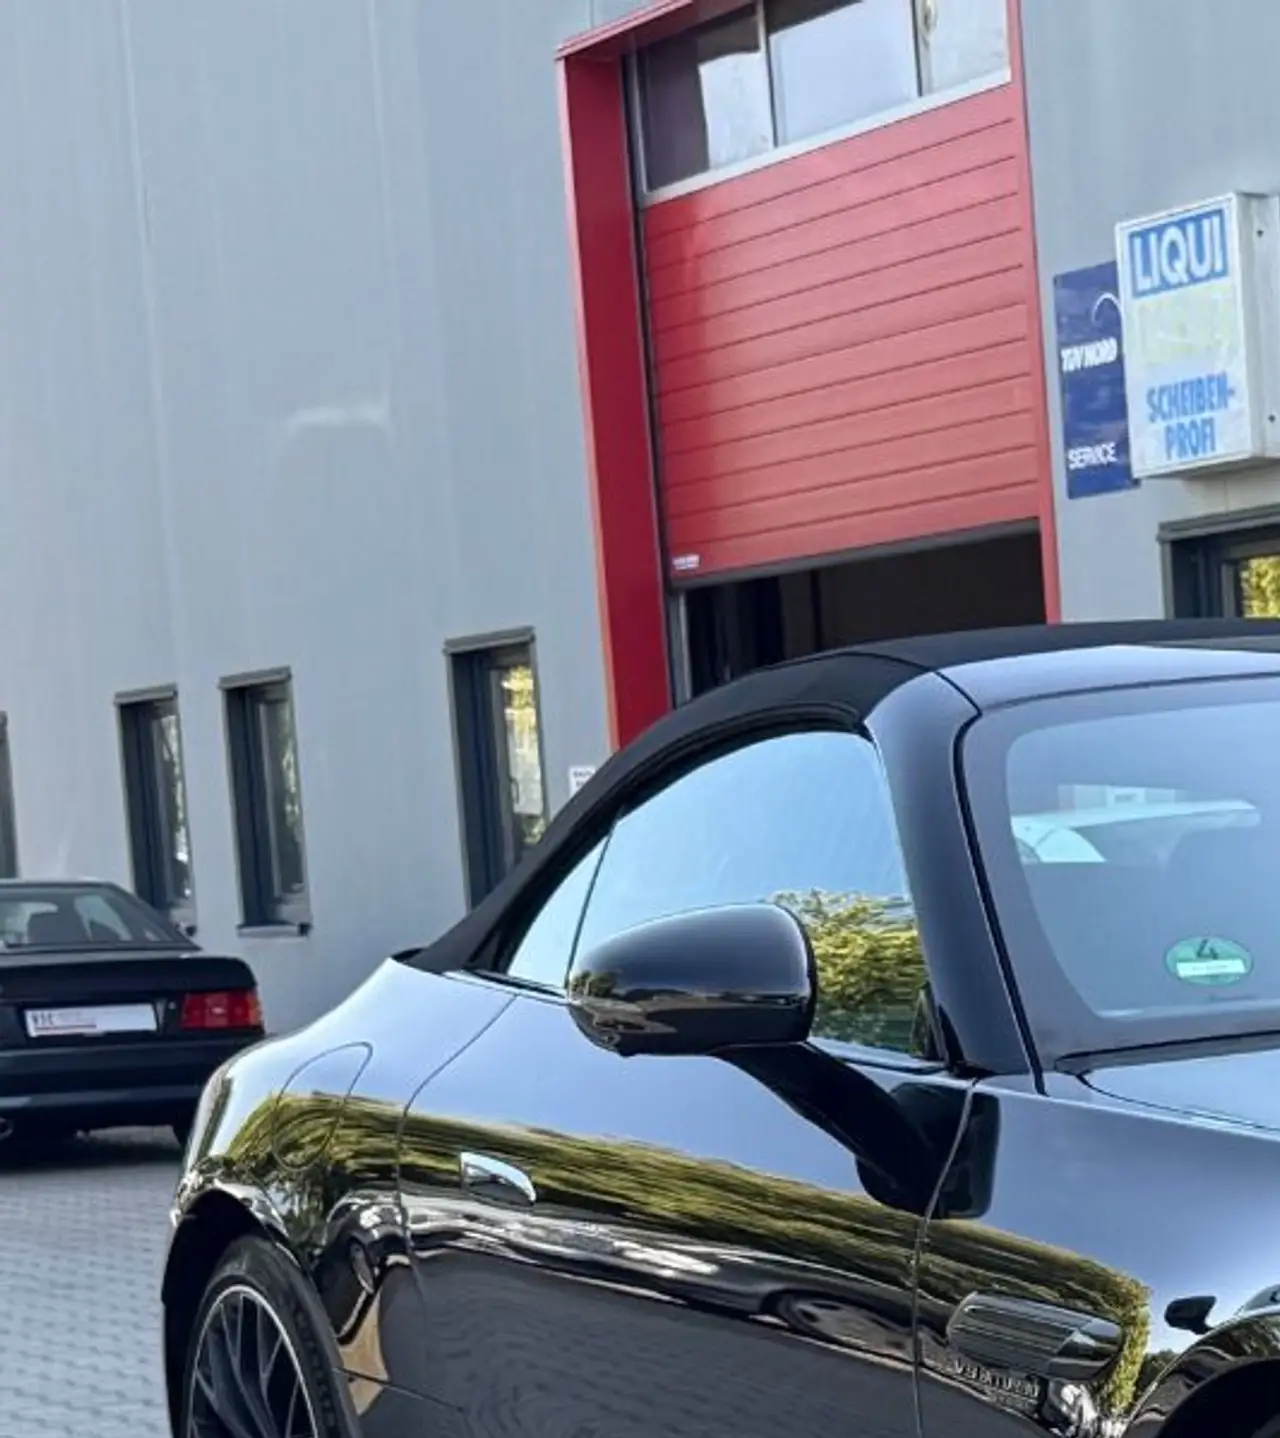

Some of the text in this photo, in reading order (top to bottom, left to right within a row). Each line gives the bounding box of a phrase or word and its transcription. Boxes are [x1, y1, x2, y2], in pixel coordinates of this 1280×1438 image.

[1133, 214, 1226, 291] LIQUI
[1146, 372, 1235, 422] SCHEIBEN-
[1068, 442, 1117, 470] SERVICE
[1164, 418, 1216, 460] PROFI
[1197, 938, 1219, 960] 4
